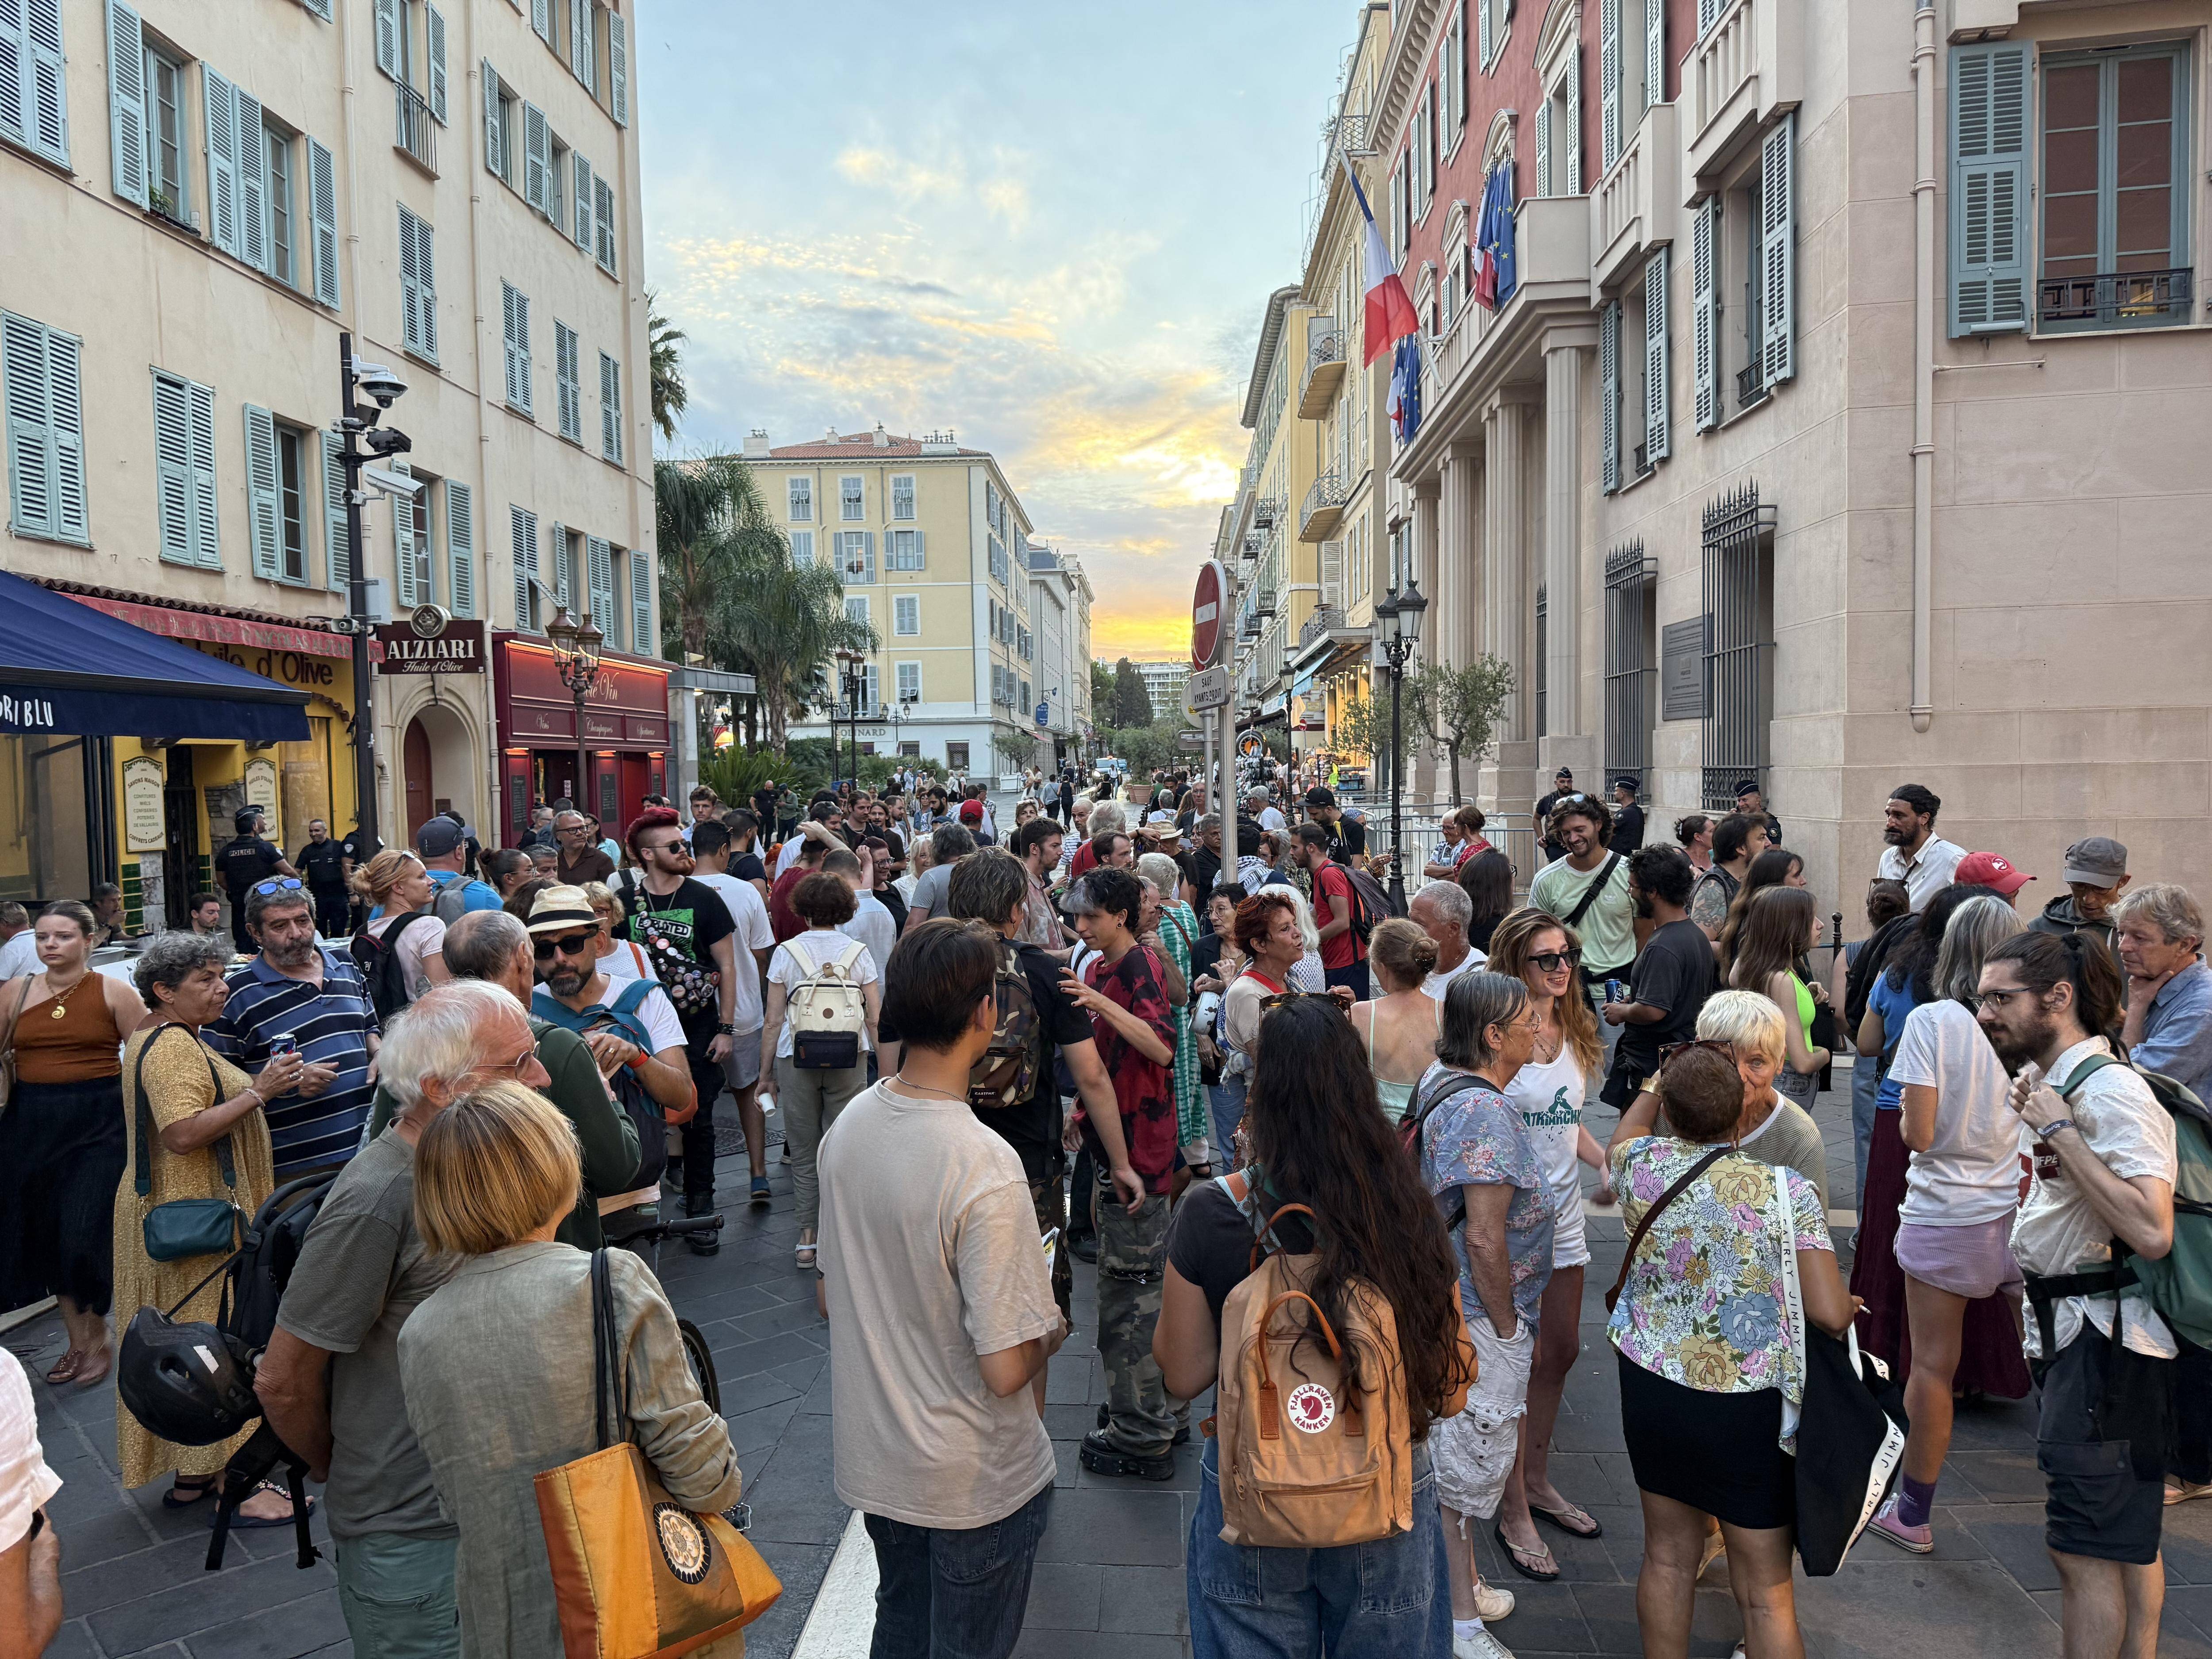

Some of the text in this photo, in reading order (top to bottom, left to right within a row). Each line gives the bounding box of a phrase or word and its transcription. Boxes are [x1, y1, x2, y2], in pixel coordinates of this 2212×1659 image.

[387, 639, 476, 659] ALZIARI
[257, 649, 333, 685] d'Olive
[403, 660, 430, 672] Huile
[431, 660, 464, 672] d'Olive
[600, 672, 619, 701] Vin
[1202, 676, 1212, 688] SAUF
[1194, 687, 1221, 704] AYANTS DROIT
[24, 699, 54, 727] BLU
[128, 777, 160, 789] SAVONS MAISON
[129, 833, 148, 844] COFFRETS
[1789, 1291, 1801, 1347] JIMMY
[1882, 1427, 1901, 1468] JIMM
